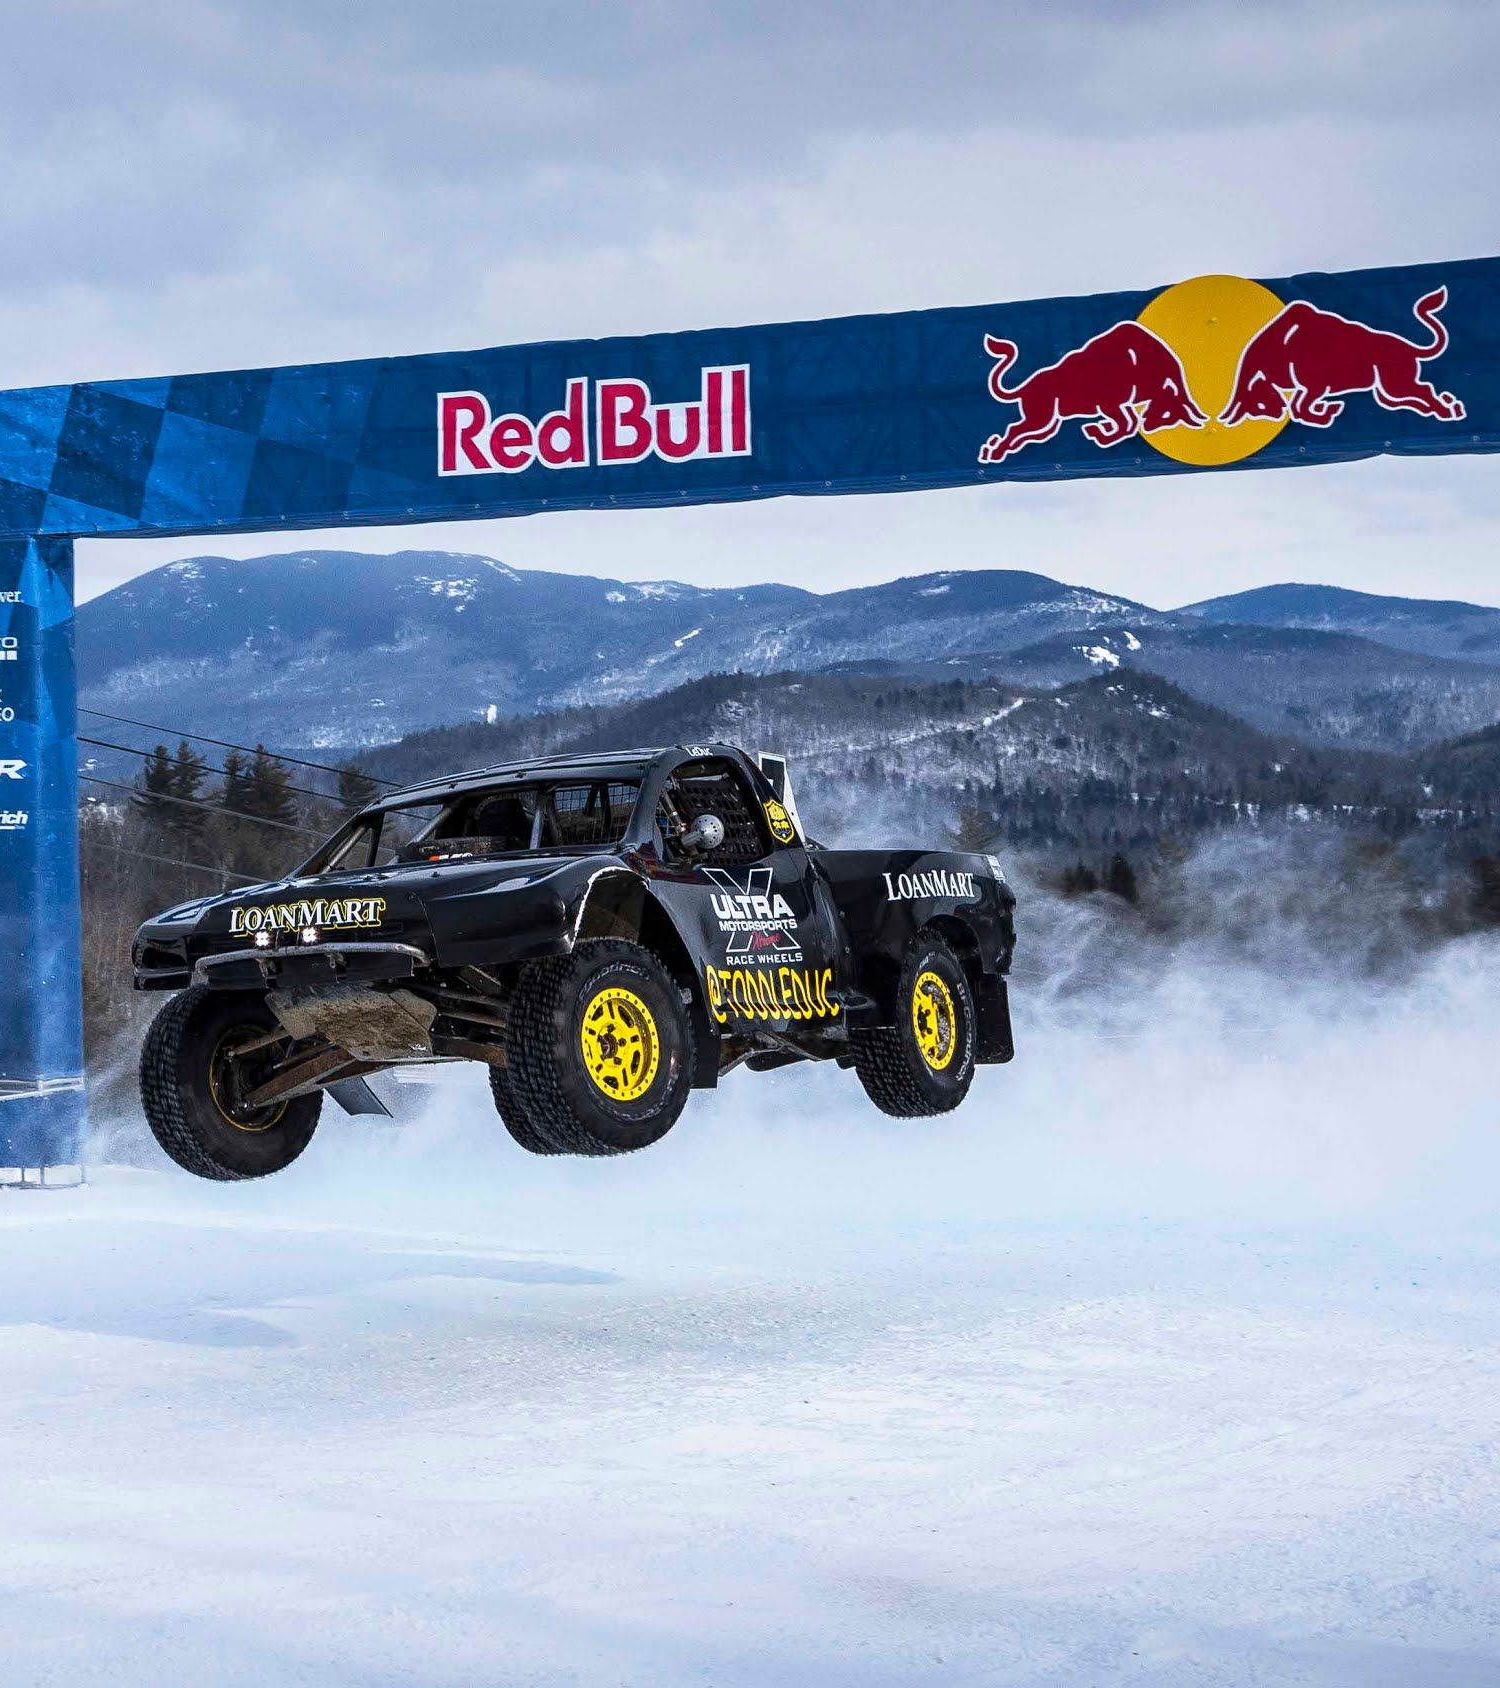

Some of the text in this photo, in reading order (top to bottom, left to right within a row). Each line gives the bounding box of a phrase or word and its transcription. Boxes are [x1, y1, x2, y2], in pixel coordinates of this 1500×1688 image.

[437, 364, 752, 477] Red Bull
[710, 893, 796, 920] ULTRA
[719, 918, 798, 932] MOTORSPORTS
[726, 952, 804, 967] RACE WHEELS
